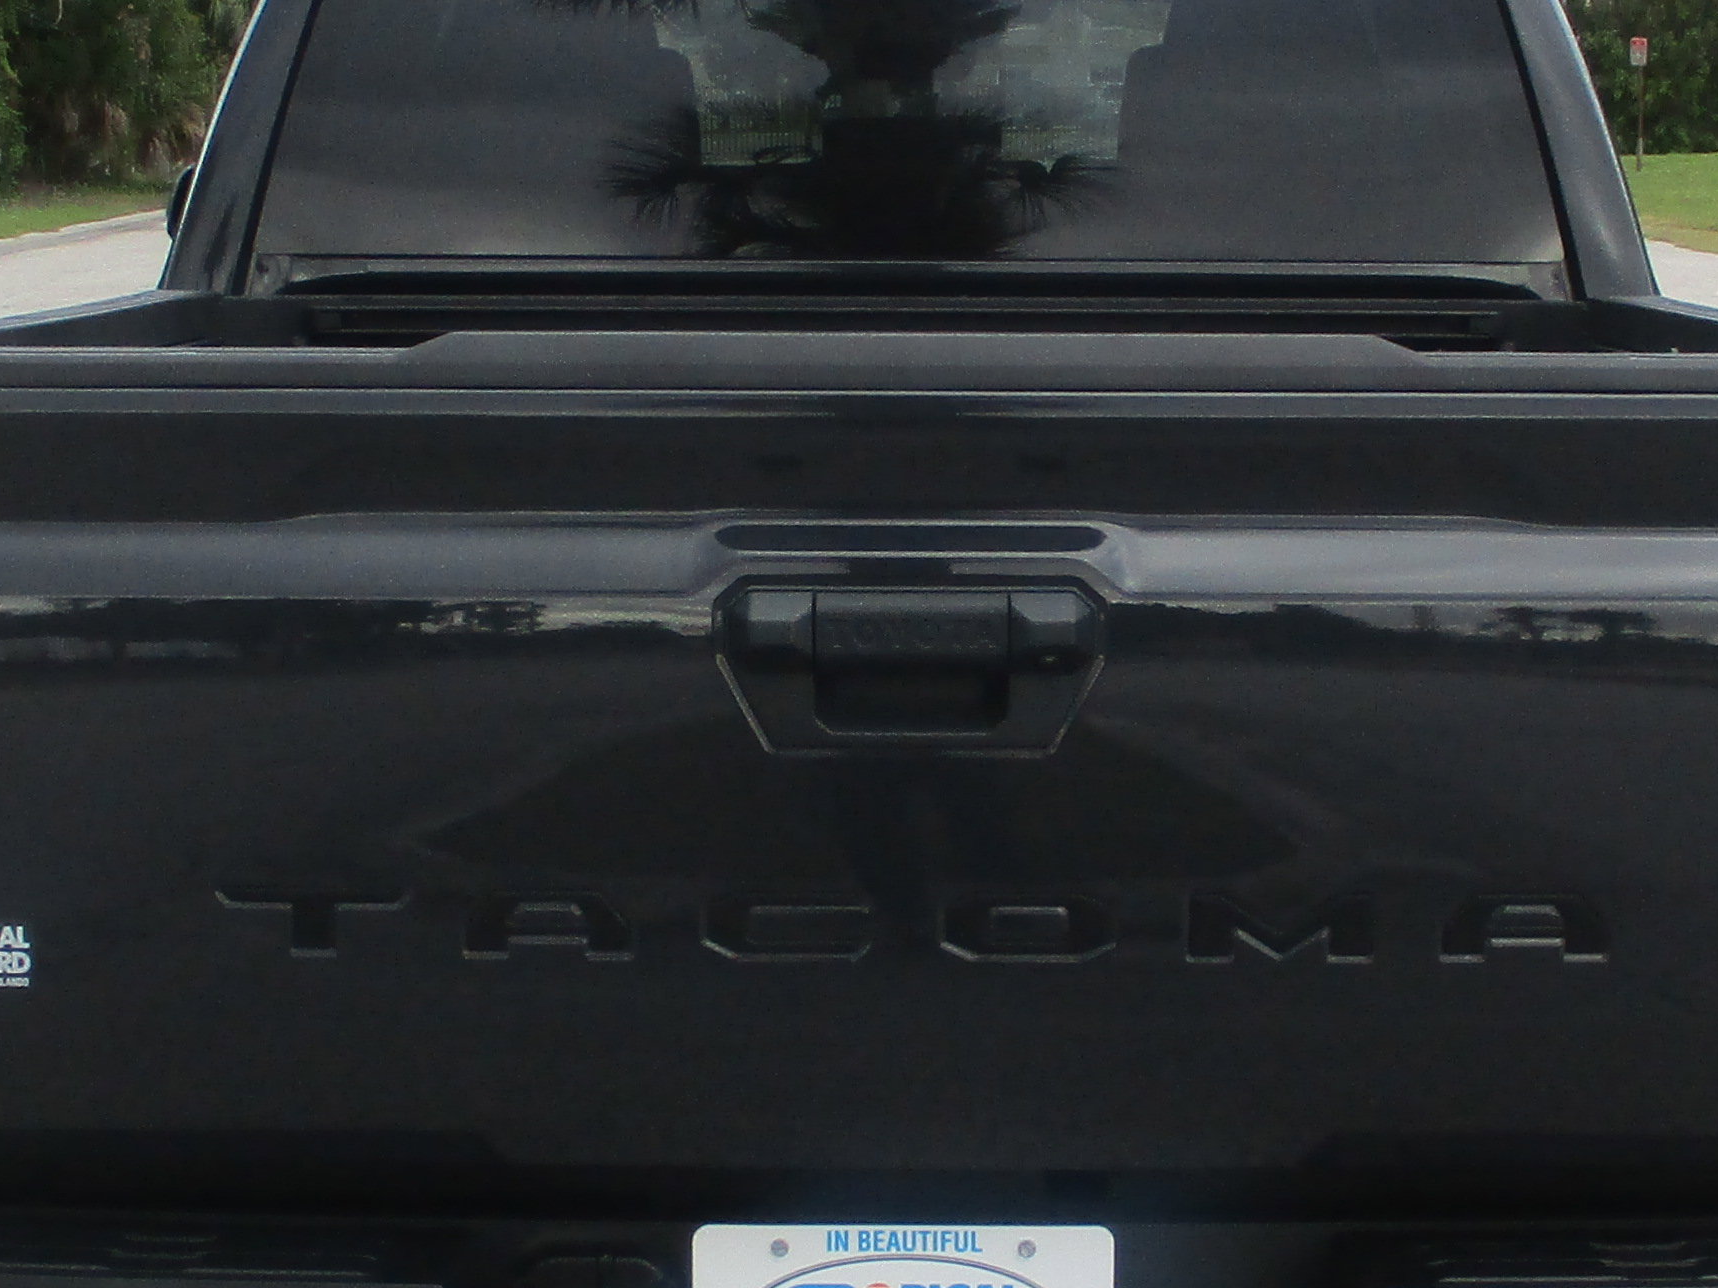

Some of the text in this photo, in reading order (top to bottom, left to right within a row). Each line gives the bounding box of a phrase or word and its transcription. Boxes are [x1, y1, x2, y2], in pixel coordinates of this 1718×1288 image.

[214, 888, 1608, 964] TACOMA
[826, 1230, 983, 1253] IN BEAUTIFUL
